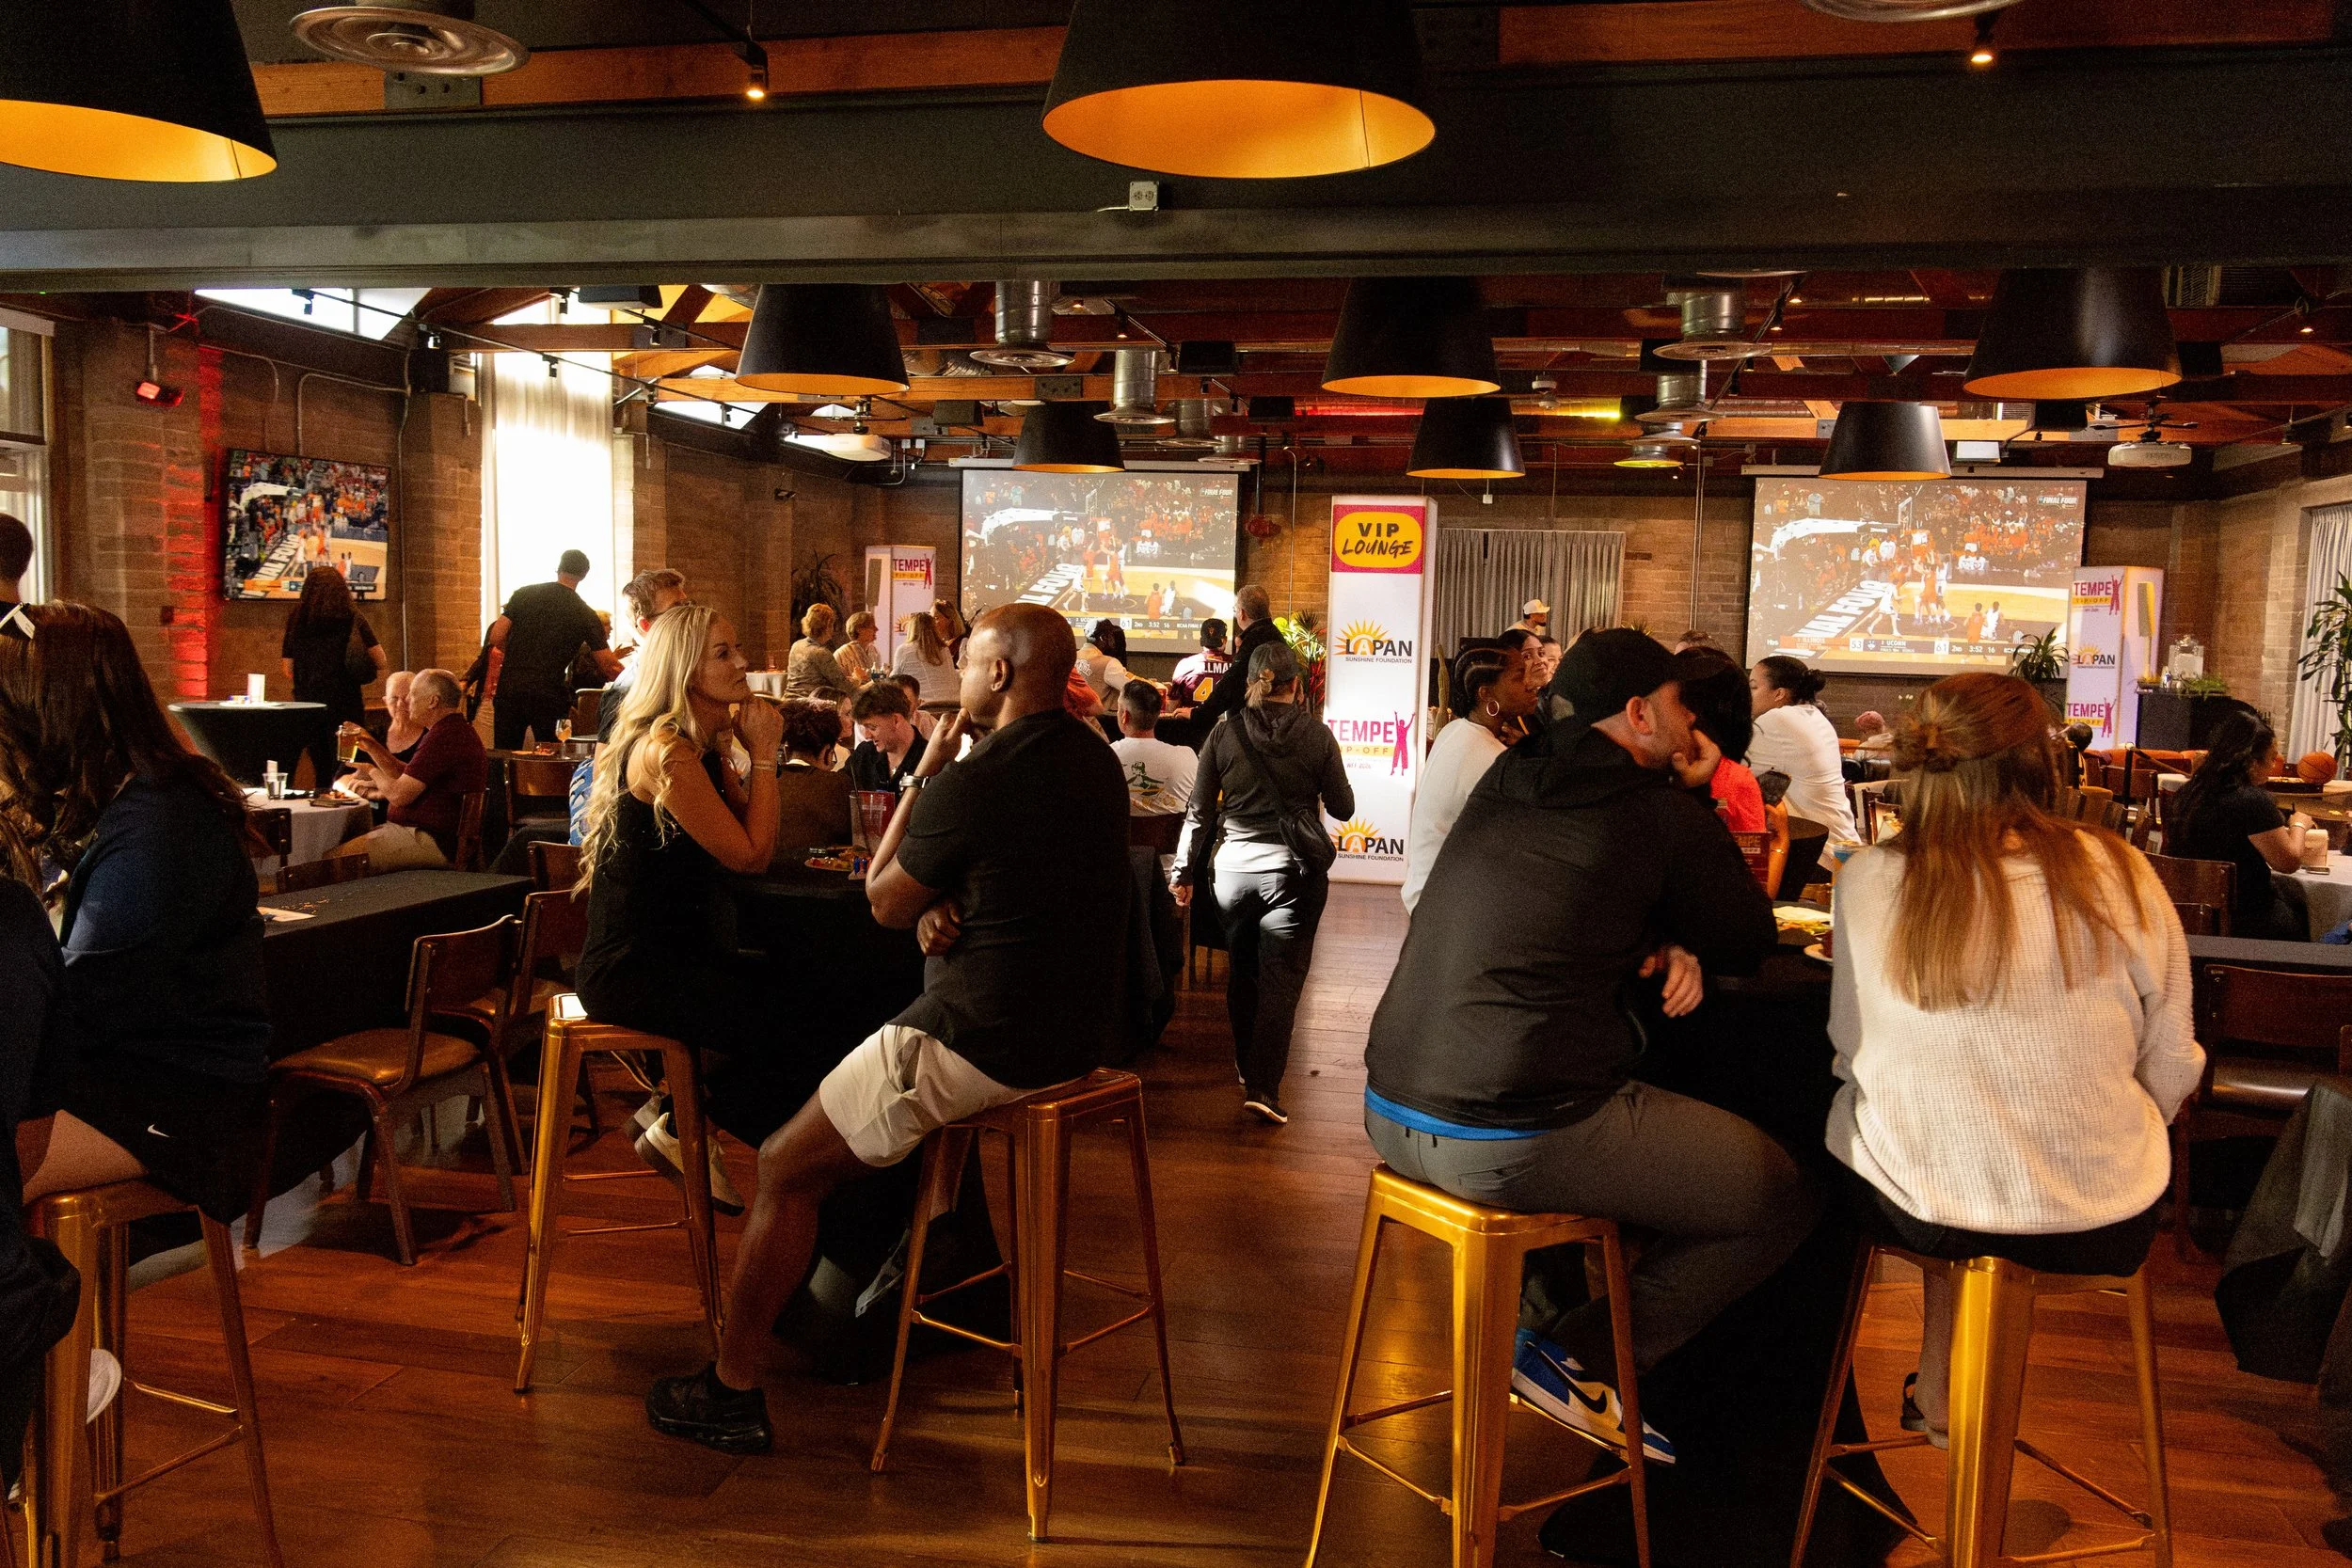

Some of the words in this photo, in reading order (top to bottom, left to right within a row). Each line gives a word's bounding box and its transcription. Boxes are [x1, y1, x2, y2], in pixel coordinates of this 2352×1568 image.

[1358, 522, 1400, 538] VIP
[1342, 539, 1414, 559] LOUNGE
[892, 558, 926, 572] TEMPE
[2074, 580, 2112, 596] TEMPE
[1345, 639, 1413, 657] LAPAN
[2066, 703, 2105, 718] TEMPE
[1327, 719, 1395, 744] TEMPE
[1338, 835, 1405, 855] LAPAN
